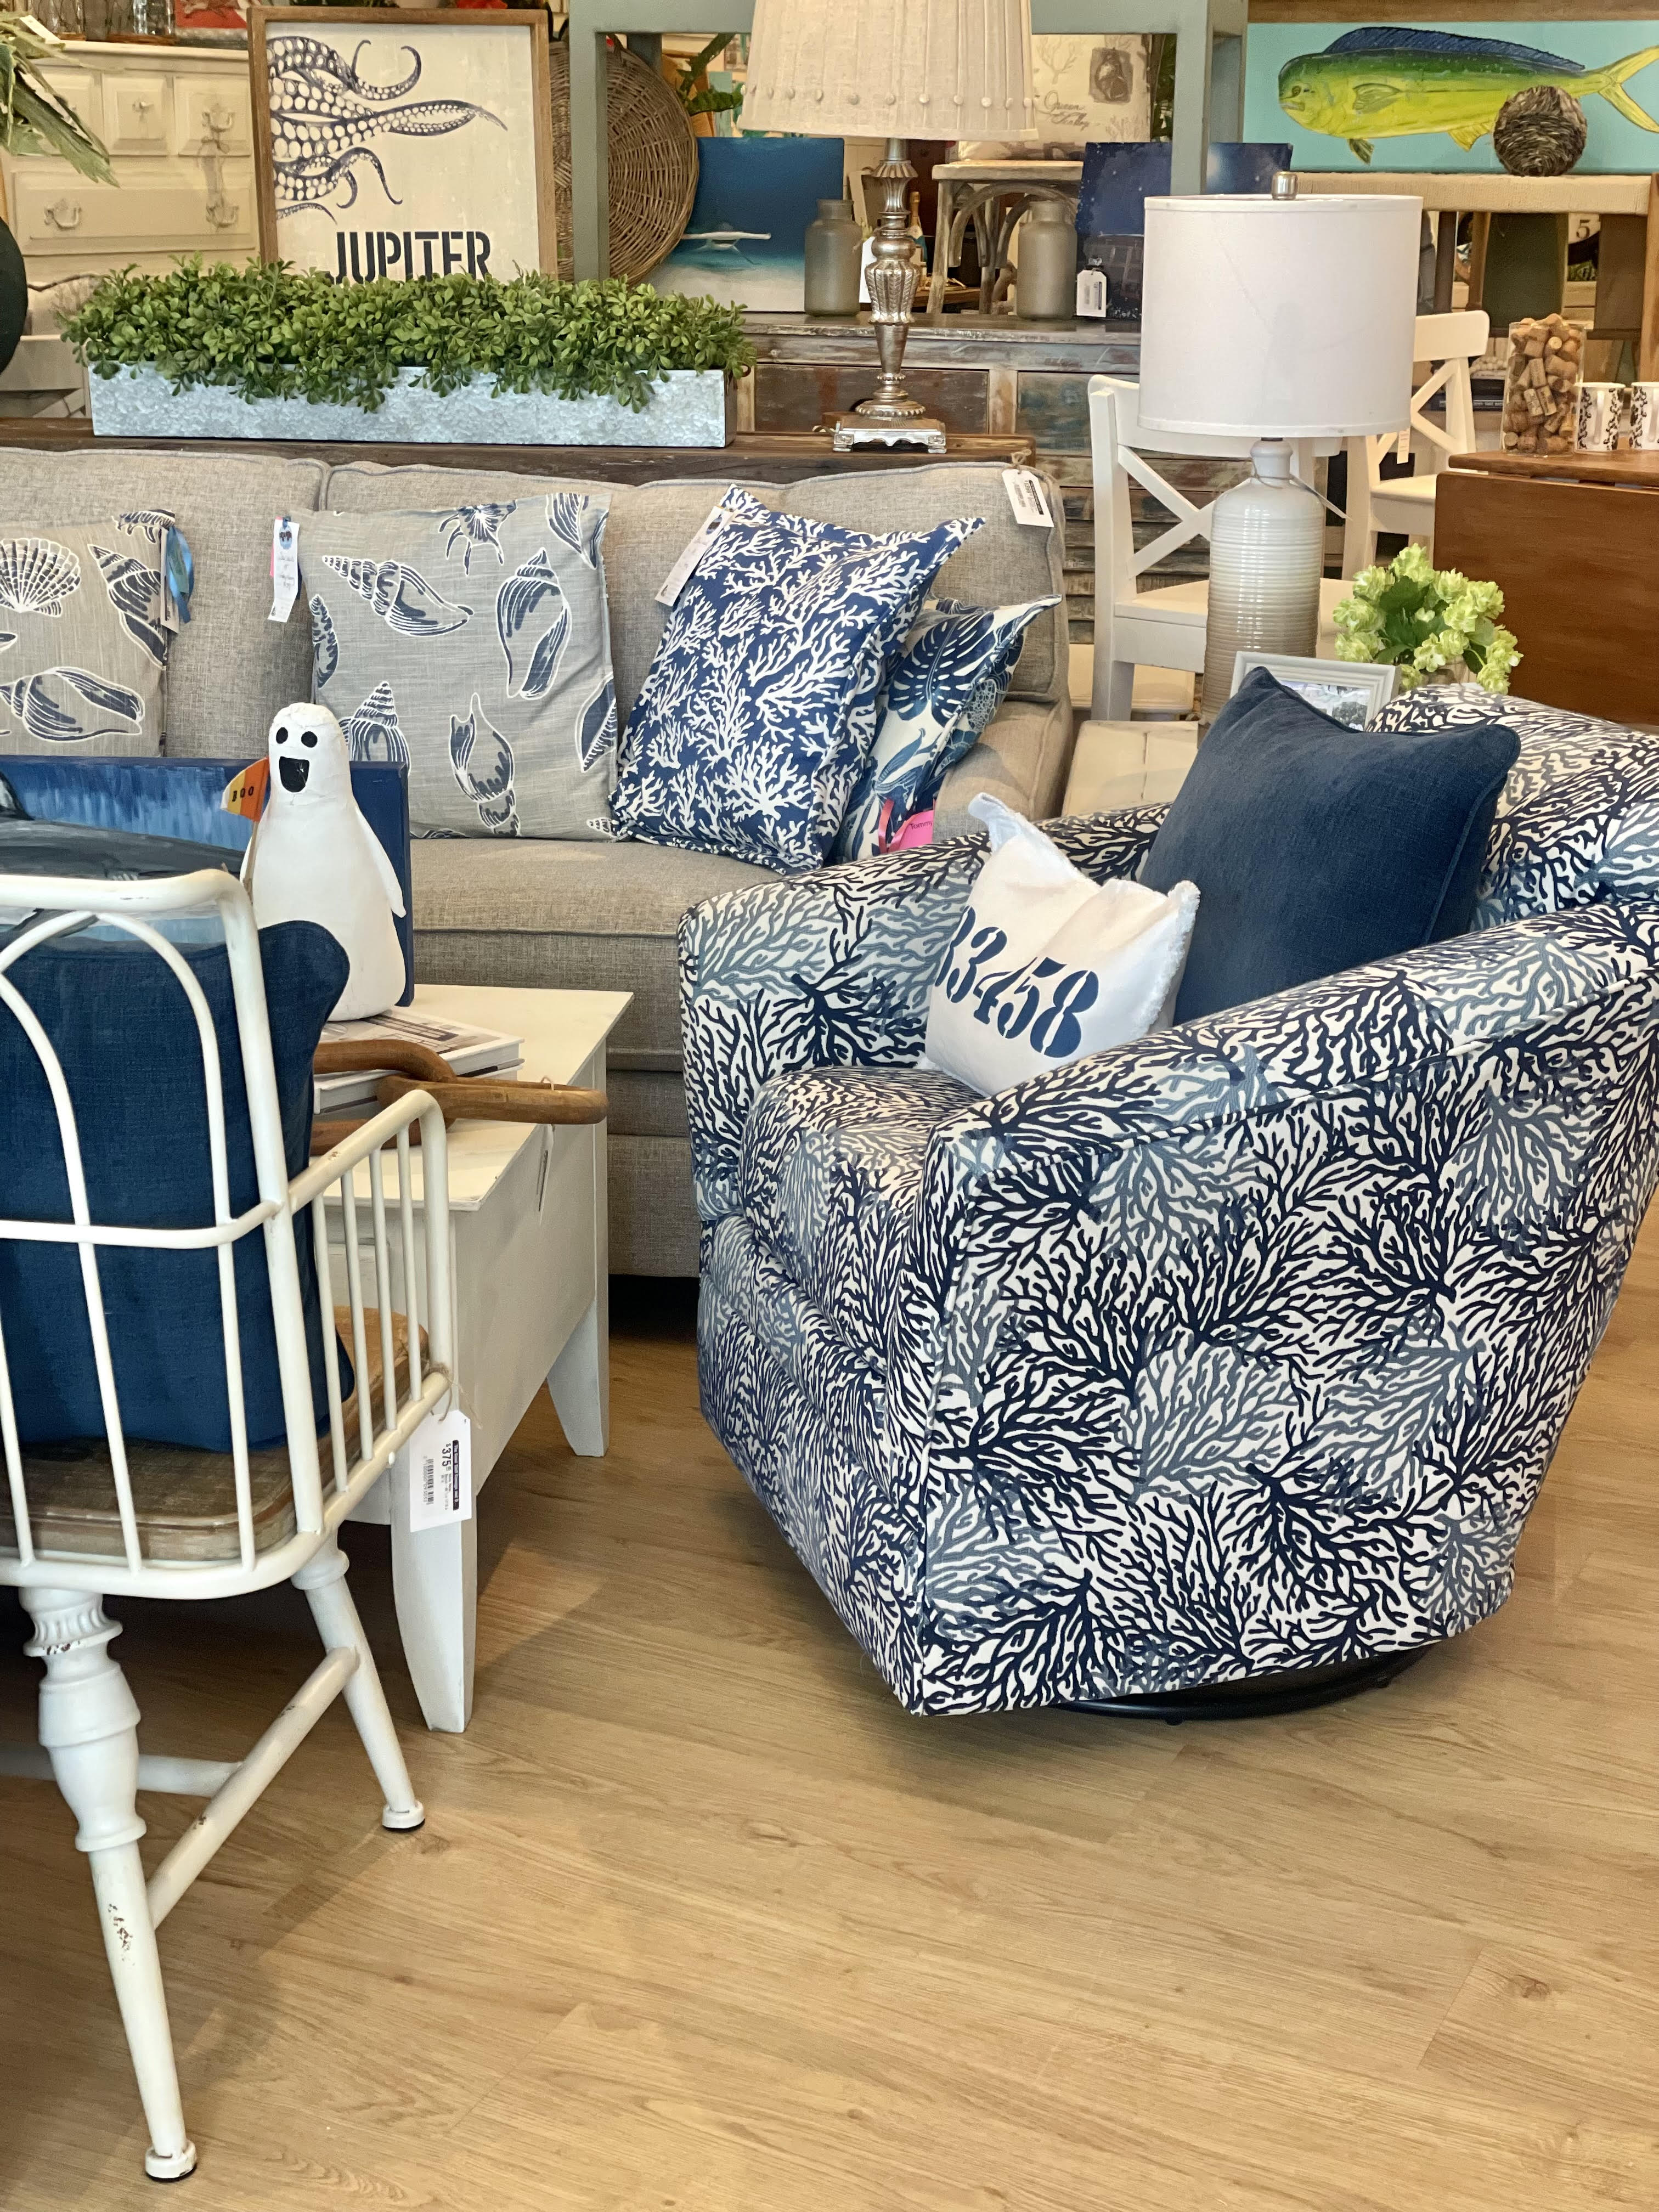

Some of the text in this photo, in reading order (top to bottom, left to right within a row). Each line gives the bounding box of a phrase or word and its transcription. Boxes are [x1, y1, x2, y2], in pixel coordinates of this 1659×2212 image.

[1576, 219, 1590, 239] 5
[325, 231, 490, 284] JUPITER
[232, 786, 254, 802] BOO
[909, 821, 933, 830] Tommy
